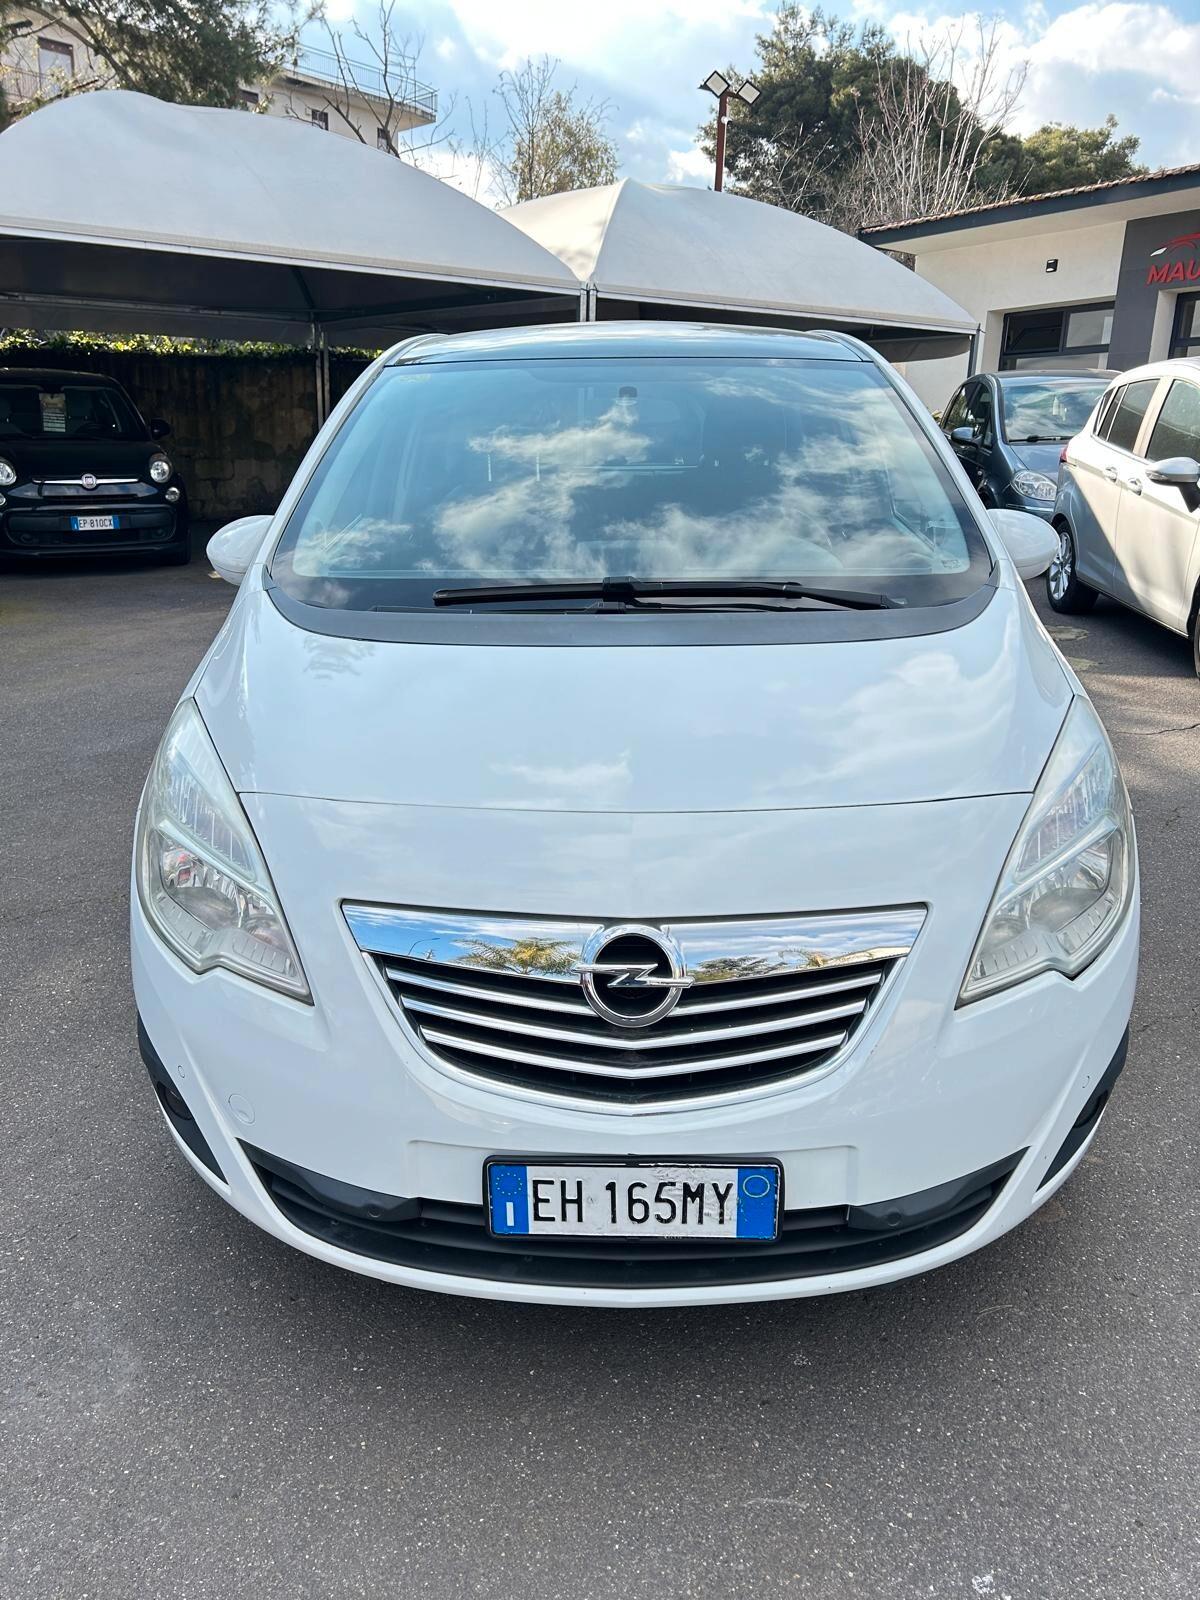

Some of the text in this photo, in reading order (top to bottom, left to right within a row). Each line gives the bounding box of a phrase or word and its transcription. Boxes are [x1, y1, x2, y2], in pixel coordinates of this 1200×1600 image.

[79, 519, 88, 528] EP
[532, 1179, 733, 1225] EH 165MY
